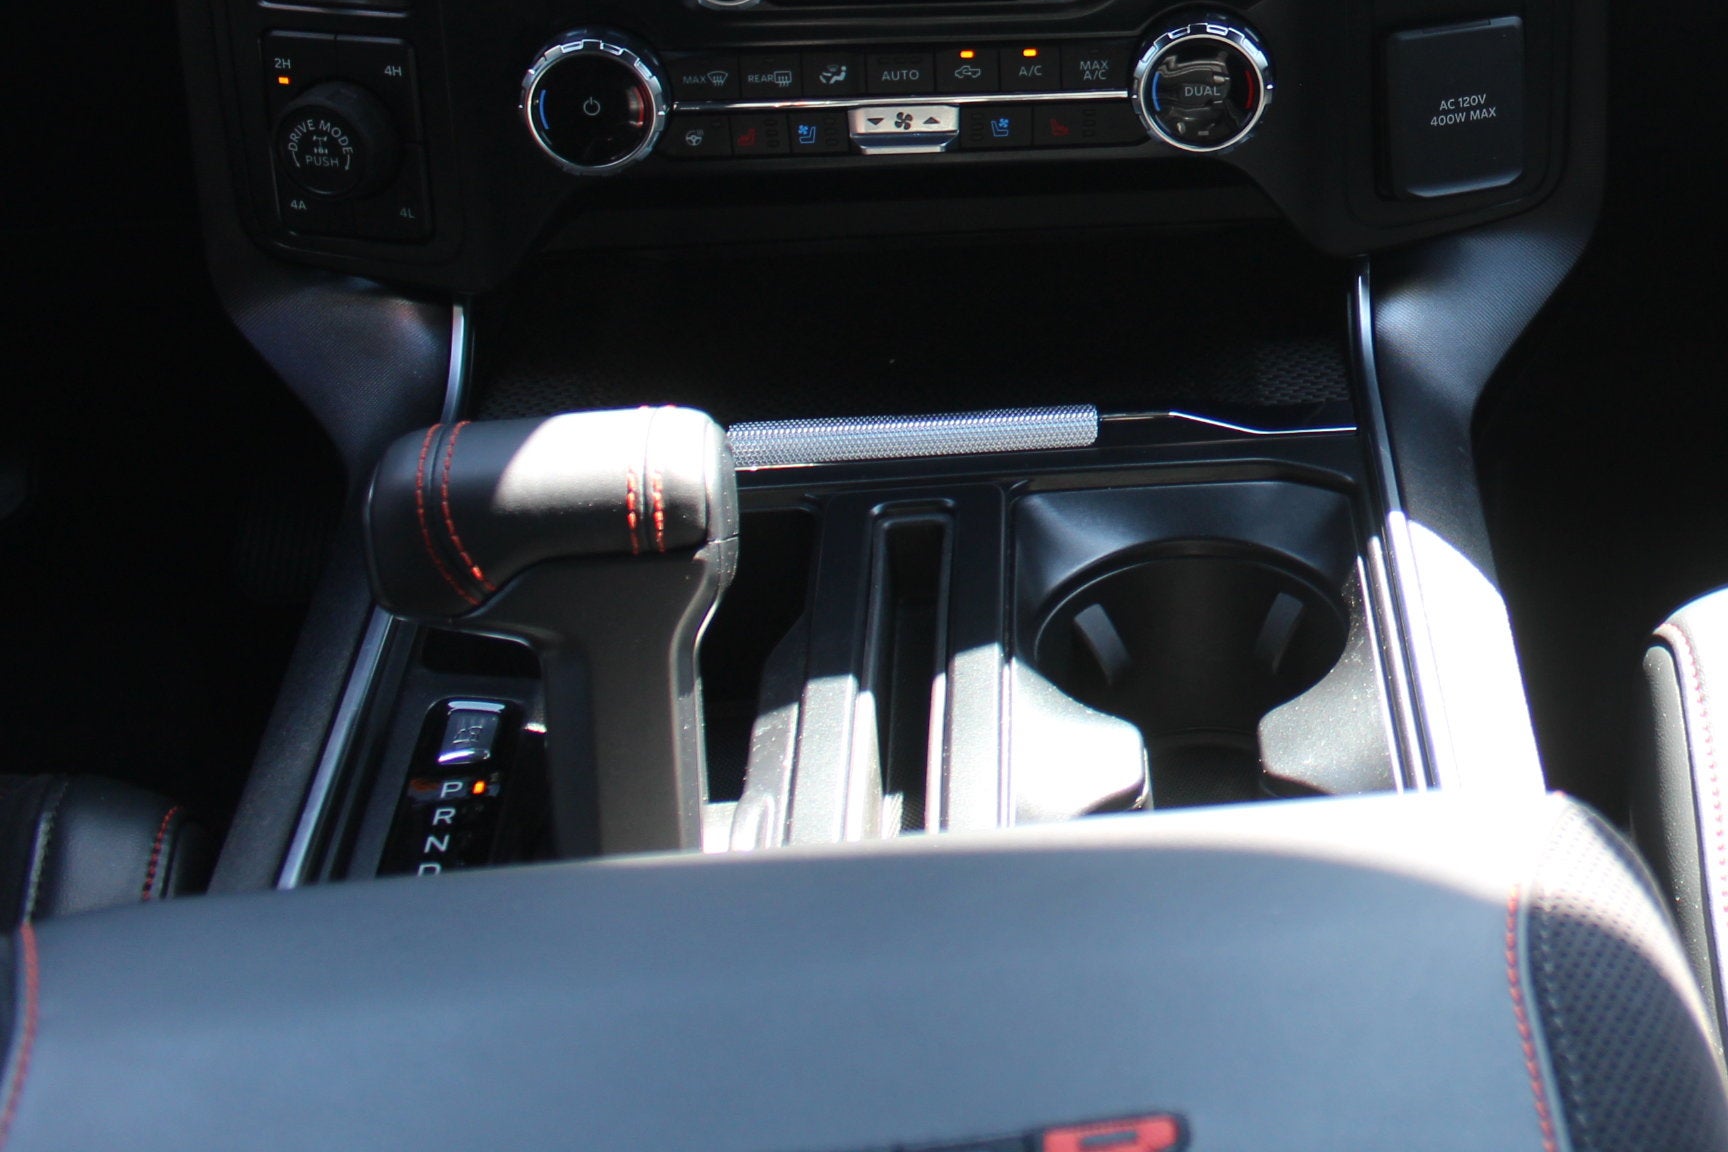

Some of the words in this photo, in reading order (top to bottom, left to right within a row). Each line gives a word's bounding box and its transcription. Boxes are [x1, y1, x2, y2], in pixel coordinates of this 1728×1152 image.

[274, 57, 292, 70] 2H
[1080, 60, 1109, 71] MAX
[384, 65, 402, 77] 4H
[881, 69, 920, 81] AUTO
[1018, 64, 1043, 78] A/C
[1083, 69, 1107, 80] A/C
[683, 75, 706, 85] MAX
[748, 73, 773, 83] REAR
[1184, 85, 1221, 97] DUAL
[1439, 98, 1455, 112] AC
[1458, 94, 1487, 109] 120V
[1430, 111, 1466, 127] 400W
[1470, 106, 1497, 122] MAX
[288, 119, 316, 153] DRIVE
[320, 122, 354, 154] MODE
[305, 155, 339, 168] PUSH
[290, 199, 307, 211] 4A
[400, 208, 415, 219] 4L
[440, 781, 463, 798] P
[432, 808, 456, 826] R
[423, 834, 450, 854] N
